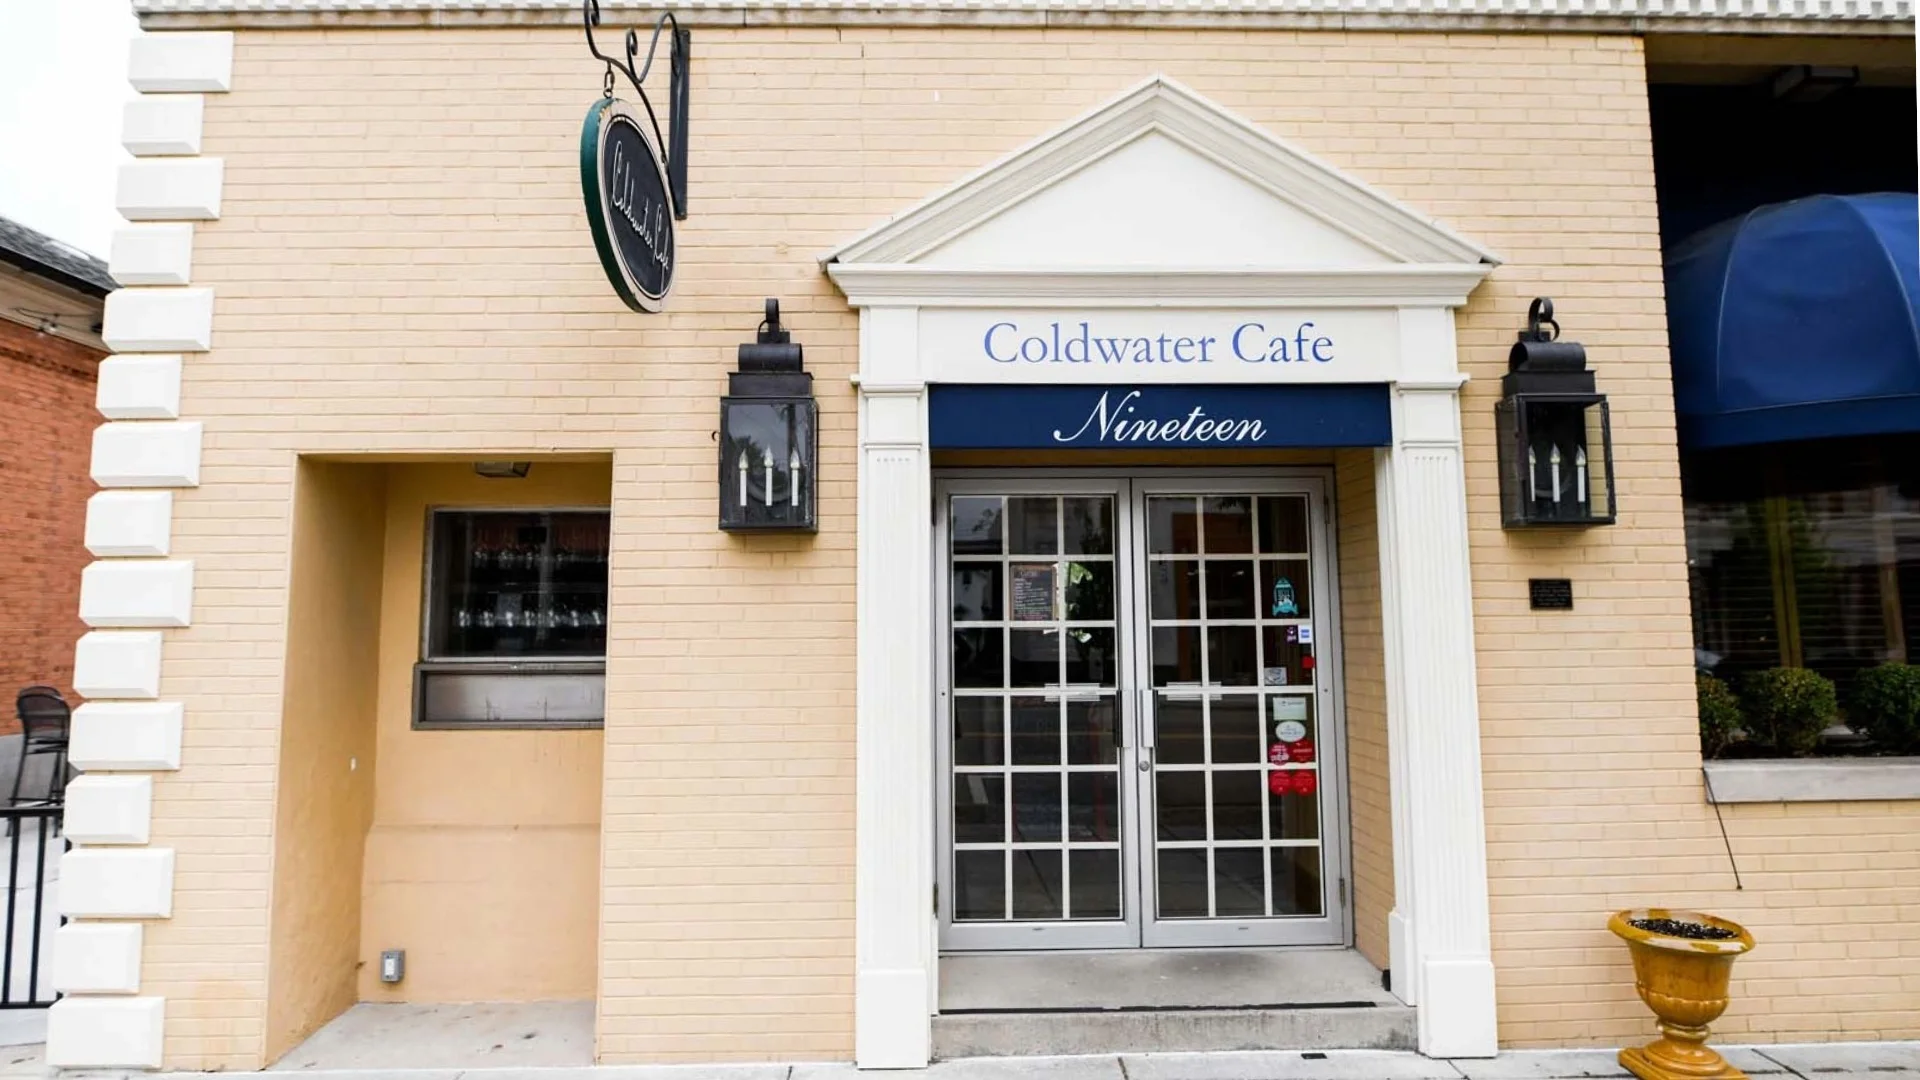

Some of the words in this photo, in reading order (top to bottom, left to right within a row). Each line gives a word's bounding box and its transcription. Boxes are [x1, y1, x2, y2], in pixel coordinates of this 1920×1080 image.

[610, 140, 653, 249] Coldwater
[652, 203, 669, 295] Cafe
[984, 321, 1216, 363] Coldwater
[1231, 321, 1334, 363] Cafe
[1053, 390, 1267, 442] Nineteen
